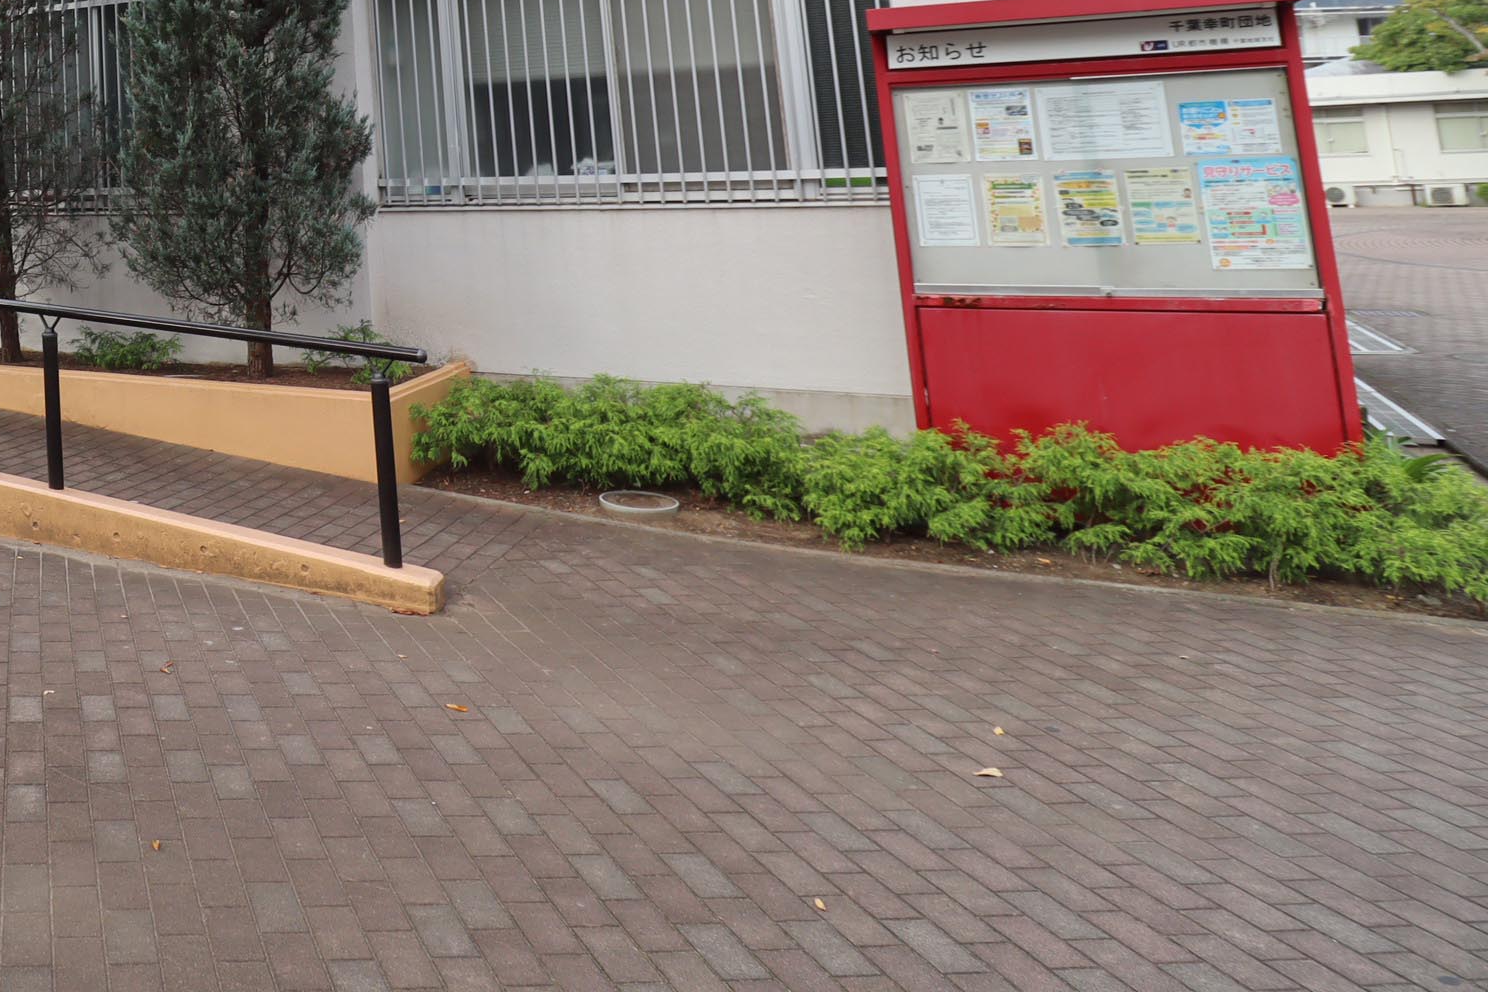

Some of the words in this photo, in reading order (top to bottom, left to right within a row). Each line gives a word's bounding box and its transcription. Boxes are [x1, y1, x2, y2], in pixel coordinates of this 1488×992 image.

[1168, 14, 1272, 32] 千葉幸町団地
[896, 41, 987, 63] お知らせ
[1203, 163, 1294, 178] 見守りサービス
